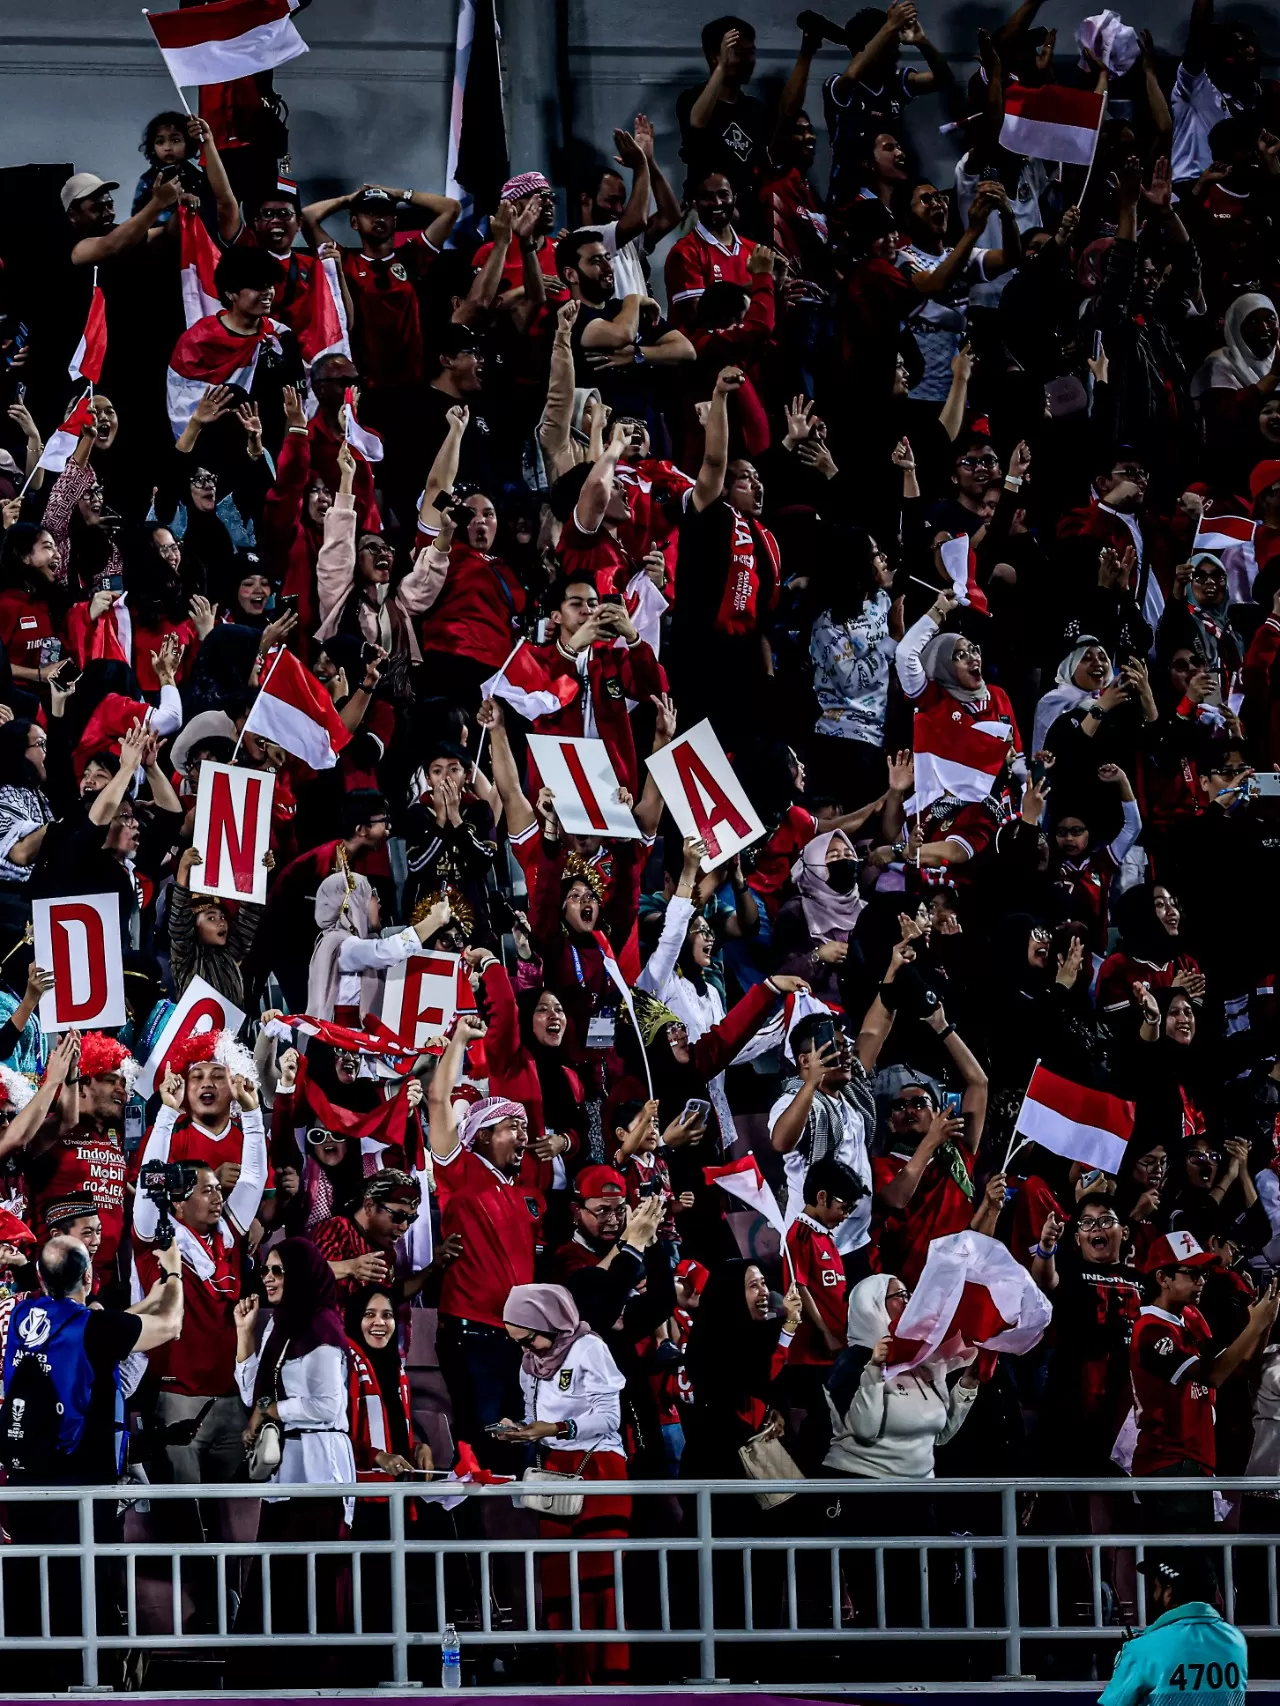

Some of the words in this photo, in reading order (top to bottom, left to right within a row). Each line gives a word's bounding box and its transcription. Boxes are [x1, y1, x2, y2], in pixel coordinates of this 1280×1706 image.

[204, 771, 261, 894] N
[559, 743, 609, 830] I
[672, 740, 752, 860] A
[49, 903, 108, 1024] D
[90, 1165, 124, 1181] Mobil
[1168, 1661, 1240, 1691] 4700
